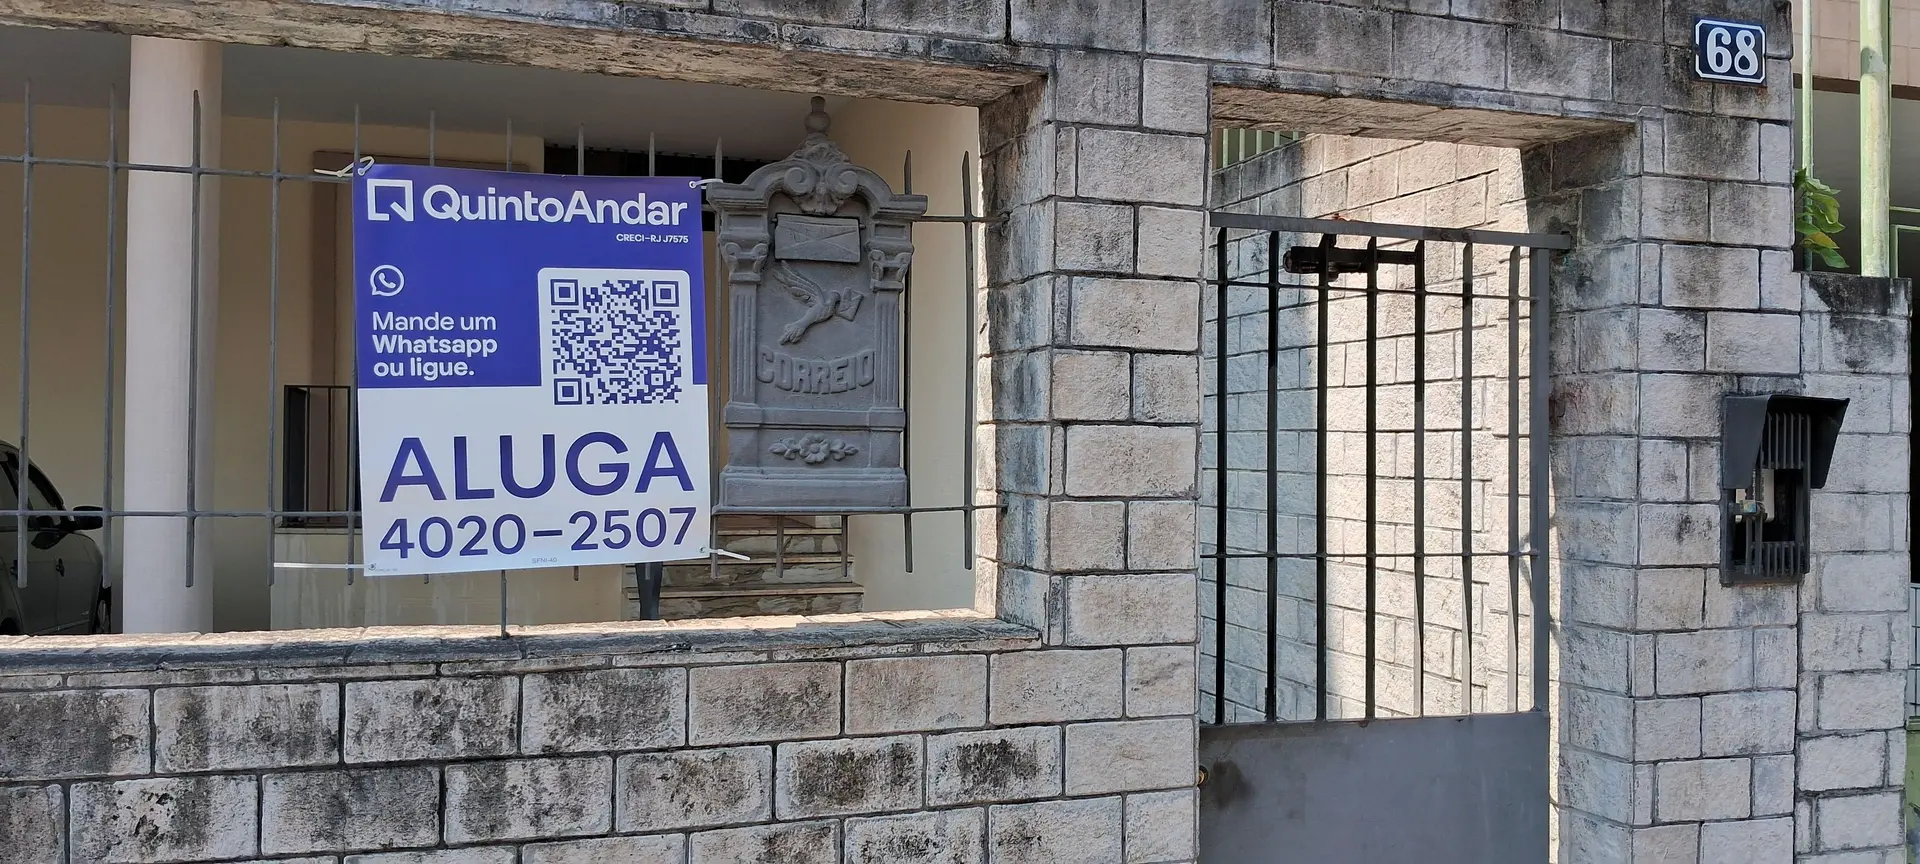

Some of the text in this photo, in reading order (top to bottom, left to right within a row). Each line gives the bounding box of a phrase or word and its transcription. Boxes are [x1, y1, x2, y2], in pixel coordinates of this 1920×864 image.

[1706, 26, 1759, 76] 68
[422, 184, 688, 226] QuintoAndar
[662, 234, 689, 244] J7575
[372, 311, 497, 331] Mande um
[372, 334, 498, 358] Whatsapp
[373, 357, 475, 381] ou ligue.
[755, 346, 876, 395] CORREIO
[379, 431, 695, 503] ALUGA
[379, 507, 697, 559] 4020-2507
